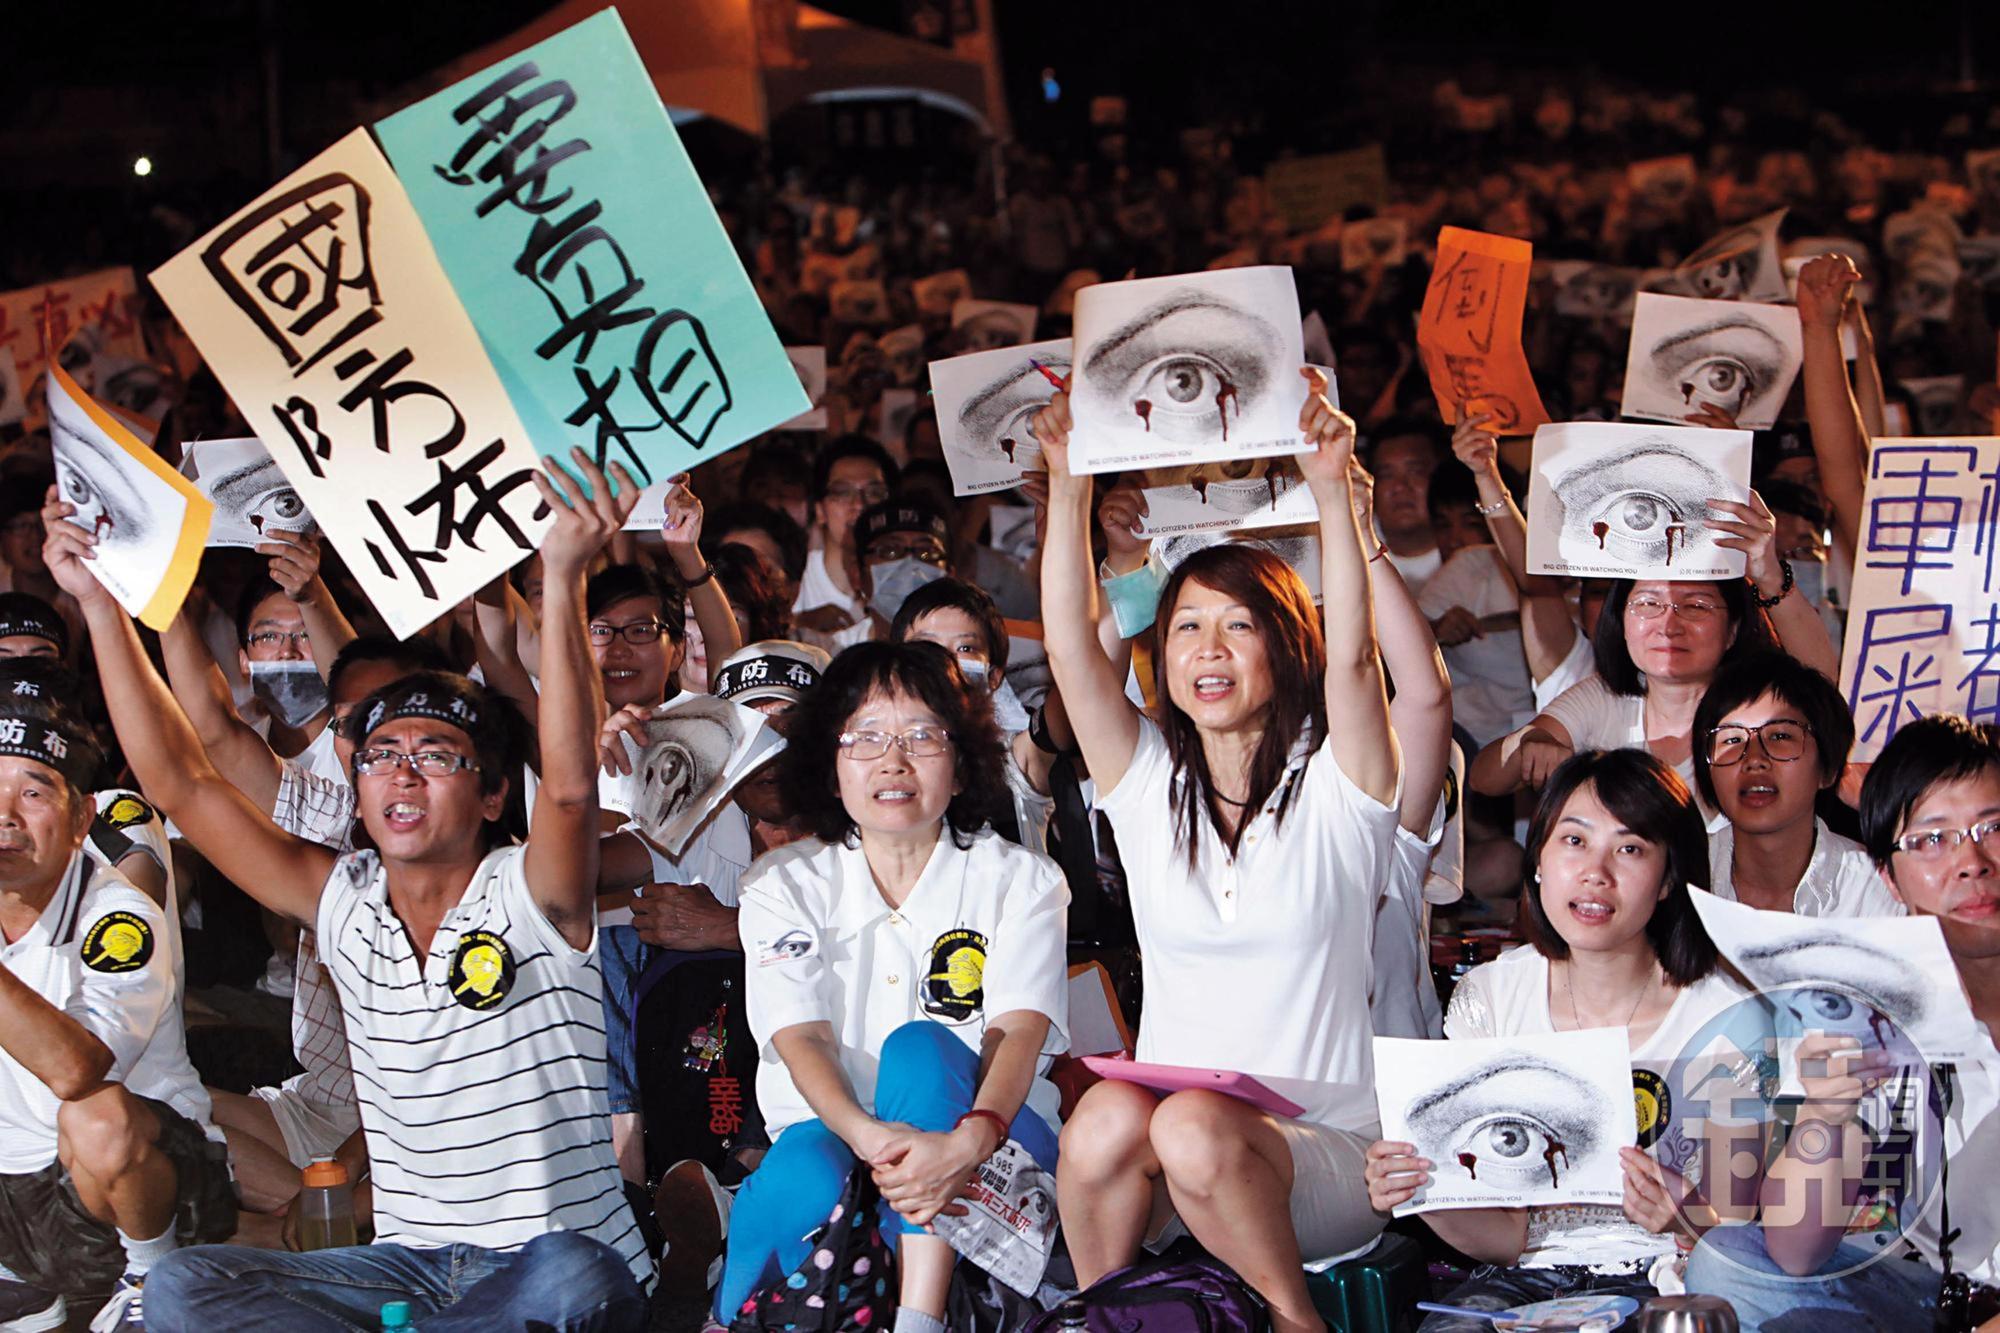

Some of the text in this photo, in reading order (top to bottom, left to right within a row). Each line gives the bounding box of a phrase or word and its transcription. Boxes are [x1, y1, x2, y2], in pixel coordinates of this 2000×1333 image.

[433, 61, 733, 489] 要真相
[201, 171, 556, 599] 國防怖
[1087, 458, 1101, 466] BIG
[1102, 456, 1130, 465] CITIZEN
[1139, 451, 1177, 461] WATCHING
[1161, 524, 1187, 533] CITIZEN
[1195, 520, 1230, 529] WATCHING
[1230, 518, 1244, 526] YOU
[1590, 566, 1624, 574] WATCHING
[1849, 446, 1978, 743] 軍屎
[1412, 1198, 1426, 1206] BIG
[1427, 1196, 1457, 1205] CITIZEN
[1466, 1195, 1505, 1203] WATCHING
[1506, 1194, 1522, 1202] YOU
